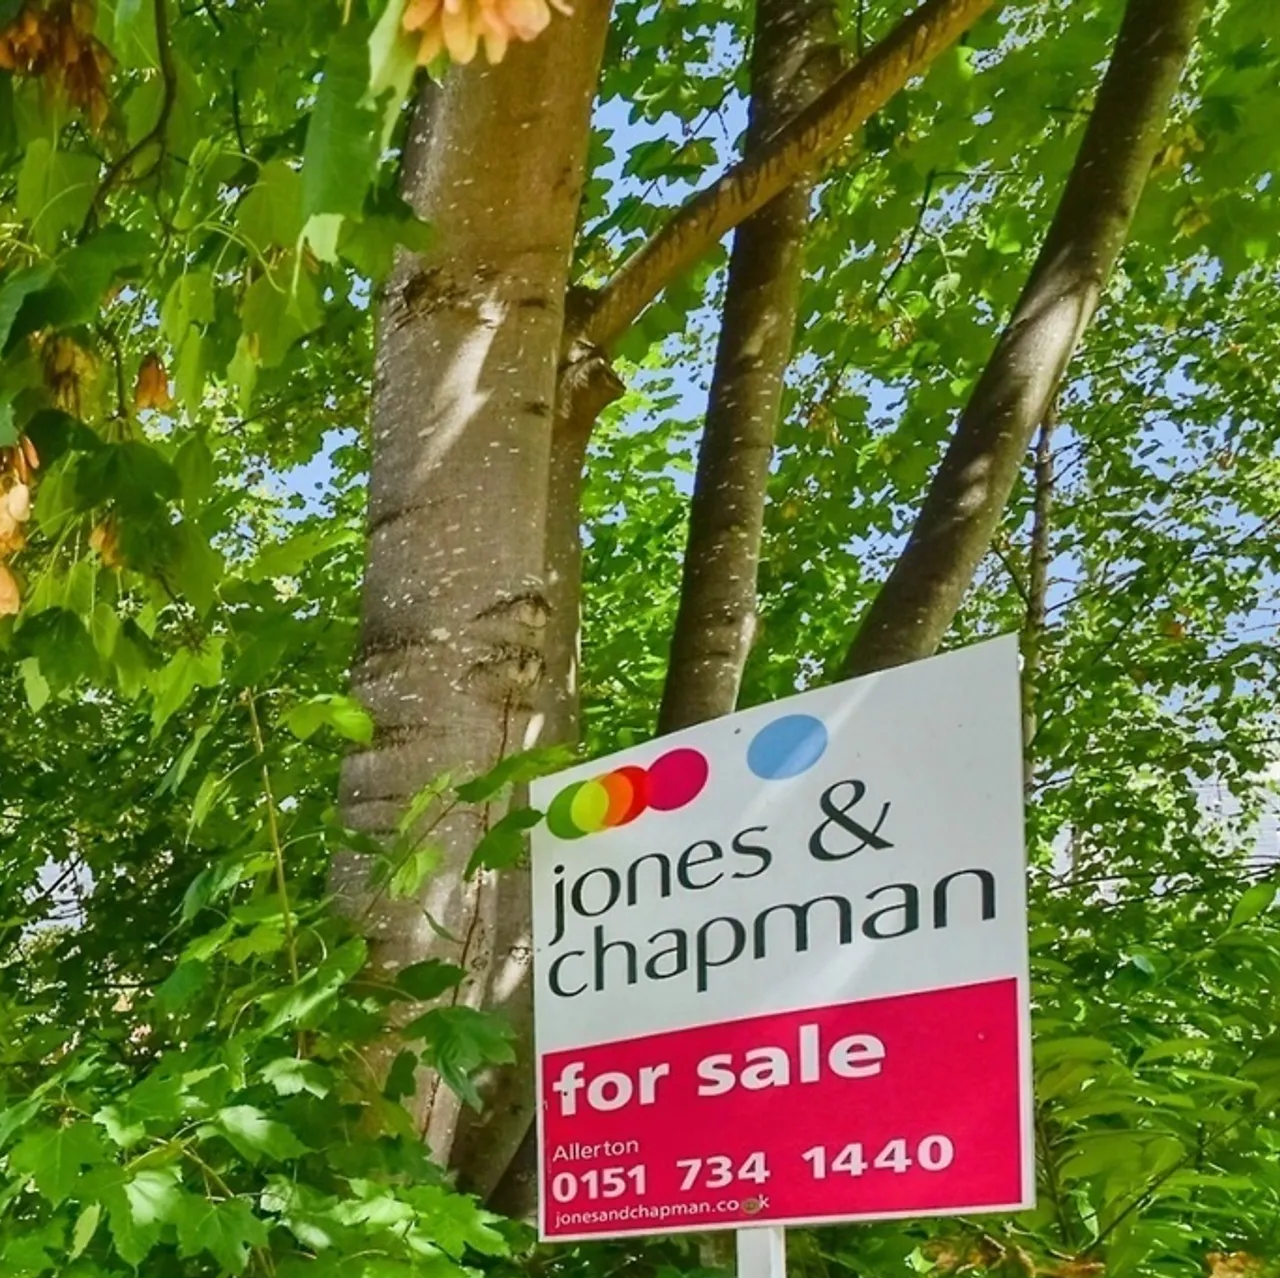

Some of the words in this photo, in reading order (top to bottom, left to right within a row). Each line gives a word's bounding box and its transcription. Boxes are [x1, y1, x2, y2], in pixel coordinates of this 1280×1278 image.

[548, 825, 773, 946] jones
[808, 779, 895, 862] &
[547, 868, 997, 998] chapman
[552, 1061, 670, 1117] for
[696, 1023, 886, 1097] sale
[552, 1139, 639, 1163] Allerton
[552, 1164, 646, 1203] 0151
[676, 1151, 771, 1192] 734
[801, 1134, 954, 1180] 1440
[554, 1194, 769, 1228] jonesandchapman.cok
